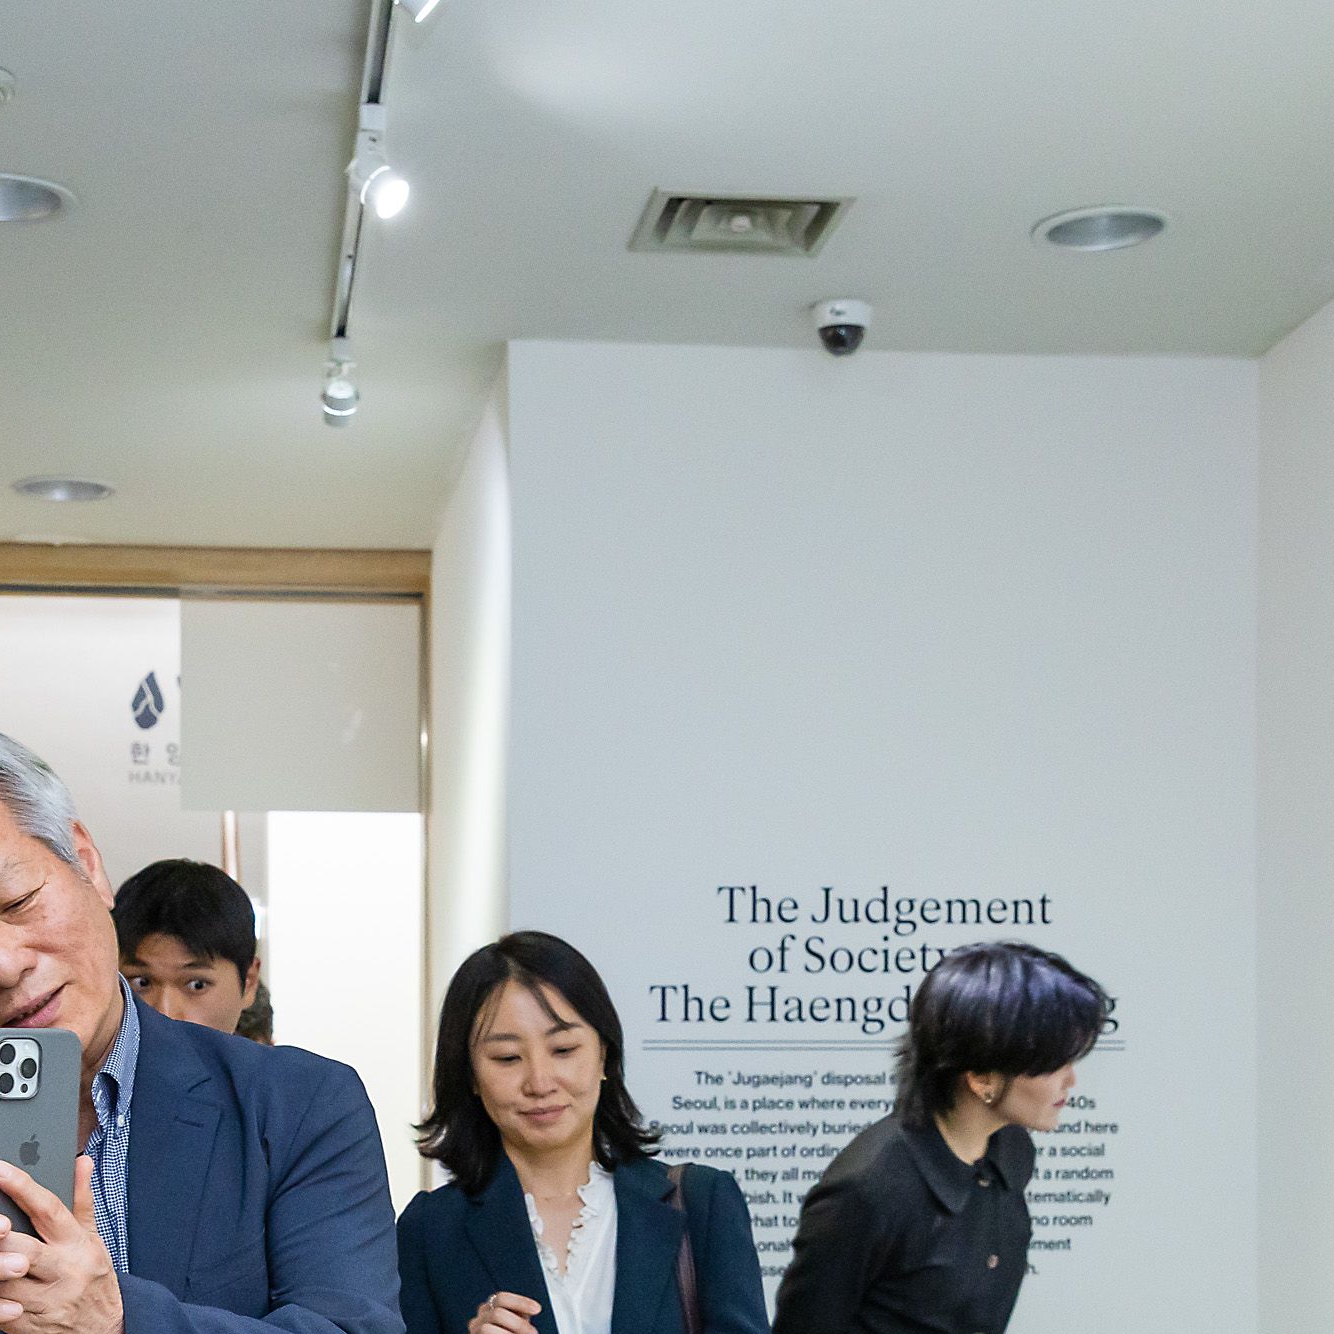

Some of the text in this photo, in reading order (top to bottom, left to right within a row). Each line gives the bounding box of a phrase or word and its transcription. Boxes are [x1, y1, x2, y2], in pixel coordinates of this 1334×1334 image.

[128, 771, 181, 784] HANY
[717, 885, 1052, 936] The Judgement
[749, 934, 797, 973] of
[649, 984, 731, 1023] The
[694, 1070, 724, 1085] The
[822, 1071, 886, 1088] disposal
[672, 1096, 721, 1111] Seoul,
[723, 1096, 736, 1110] is
[740, 1099, 749, 1110] a
[752, 1096, 794, 1112] place
[797, 1096, 845, 1110] where
[698, 1124, 728, 1135] was
[731, 1120, 818, 1138] collectively
[1084, 1121, 1119, 1134] here
[663, 1147, 701, 1158] were
[704, 1147, 743, 1158] once
[746, 1145, 777, 1160] part
[781, 1144, 796, 1158] of
[1048, 1146, 1057, 1157] a
[1060, 1143, 1105, 1157] social
[745, 1168, 778, 1184] they
[781, 1167, 799, 1181] all
[1043, 1169, 1052, 1180] a
[1054, 1166, 1114, 1180] random
[783, 1191, 793, 1204] It
[751, 1215, 779, 1228] hat
[1052, 1214, 1093, 1226] room
